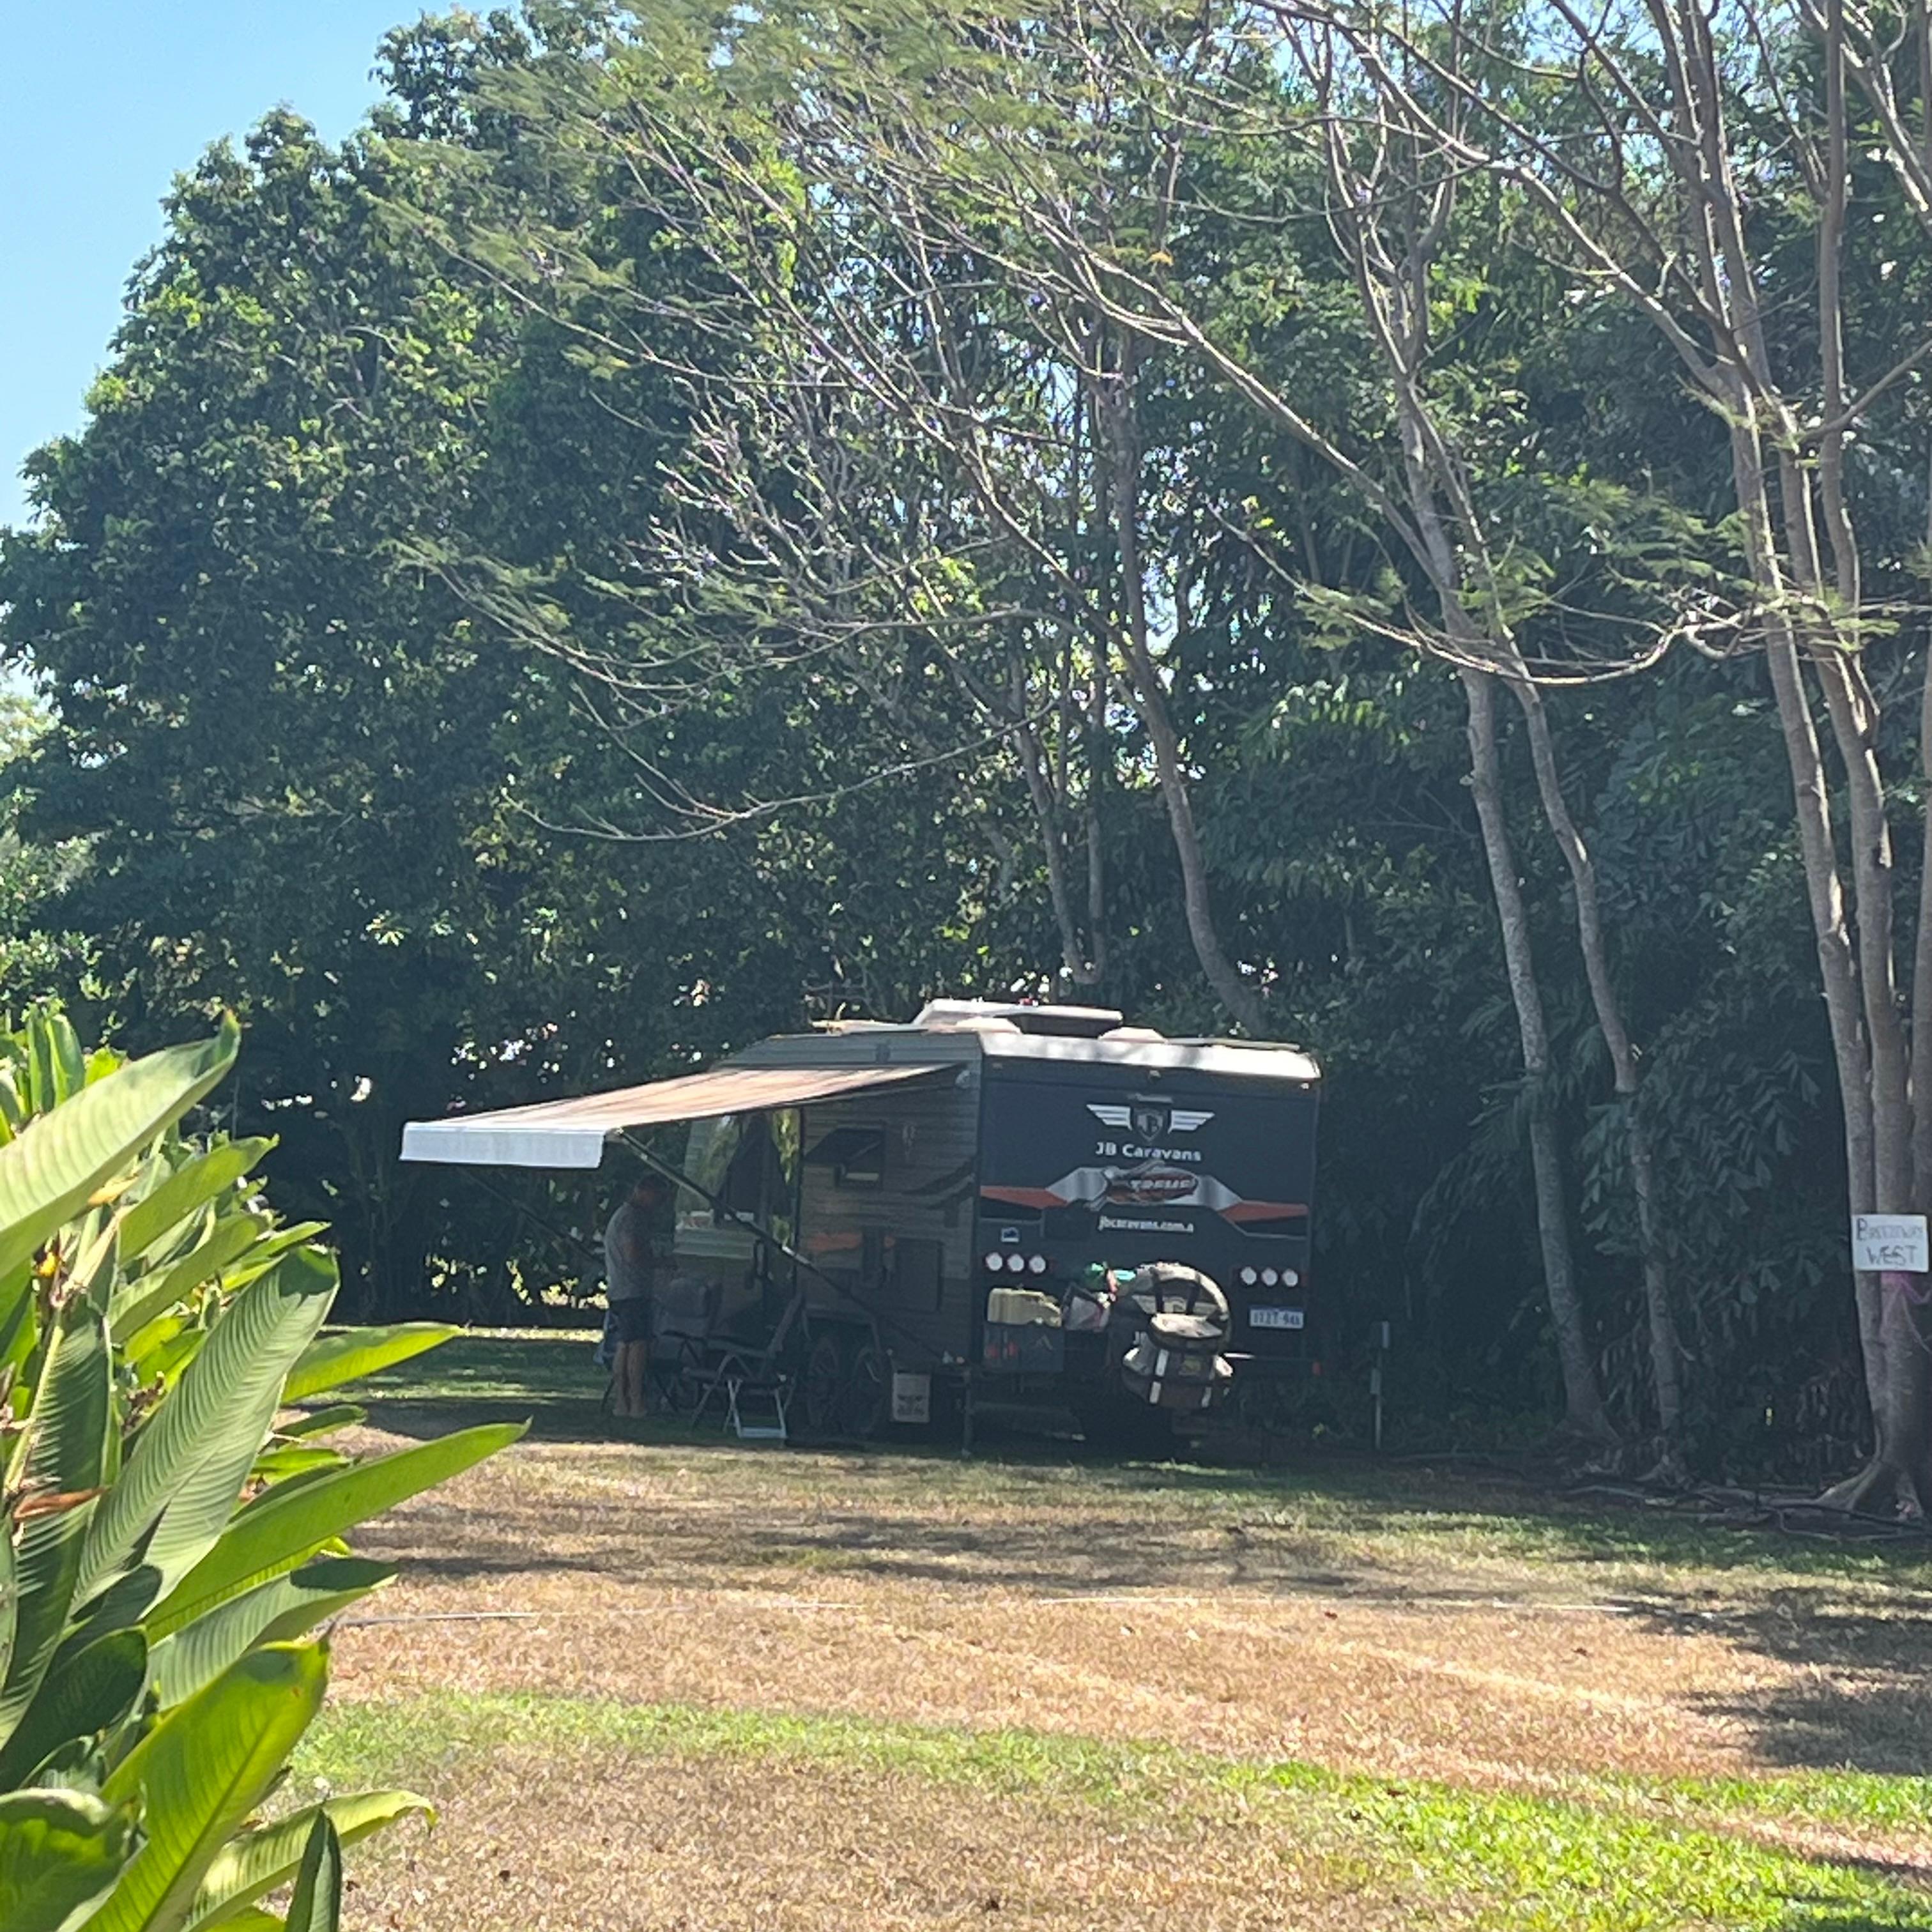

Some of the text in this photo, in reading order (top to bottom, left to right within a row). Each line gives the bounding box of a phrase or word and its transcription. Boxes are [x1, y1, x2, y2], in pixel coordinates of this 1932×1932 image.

[1096, 1142, 1201, 1162] JB Caravans
[1866, 1245, 1918, 1266] WEST
